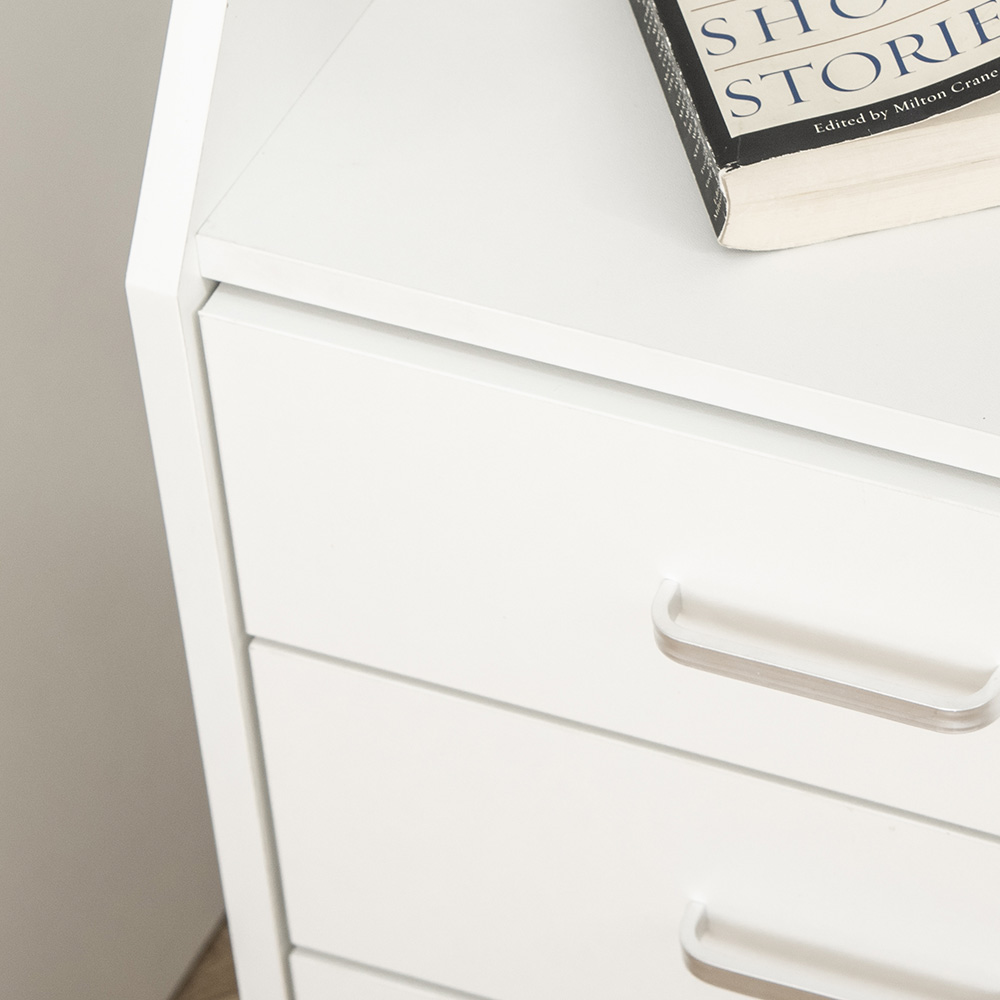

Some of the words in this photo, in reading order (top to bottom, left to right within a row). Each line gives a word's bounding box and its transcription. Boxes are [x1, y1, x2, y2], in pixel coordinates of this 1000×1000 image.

[813, 112, 867, 135] Edited
[868, 108, 889, 121] by
[893, 88, 948, 114] Milton
[950, 68, 1000, 94] Crane
